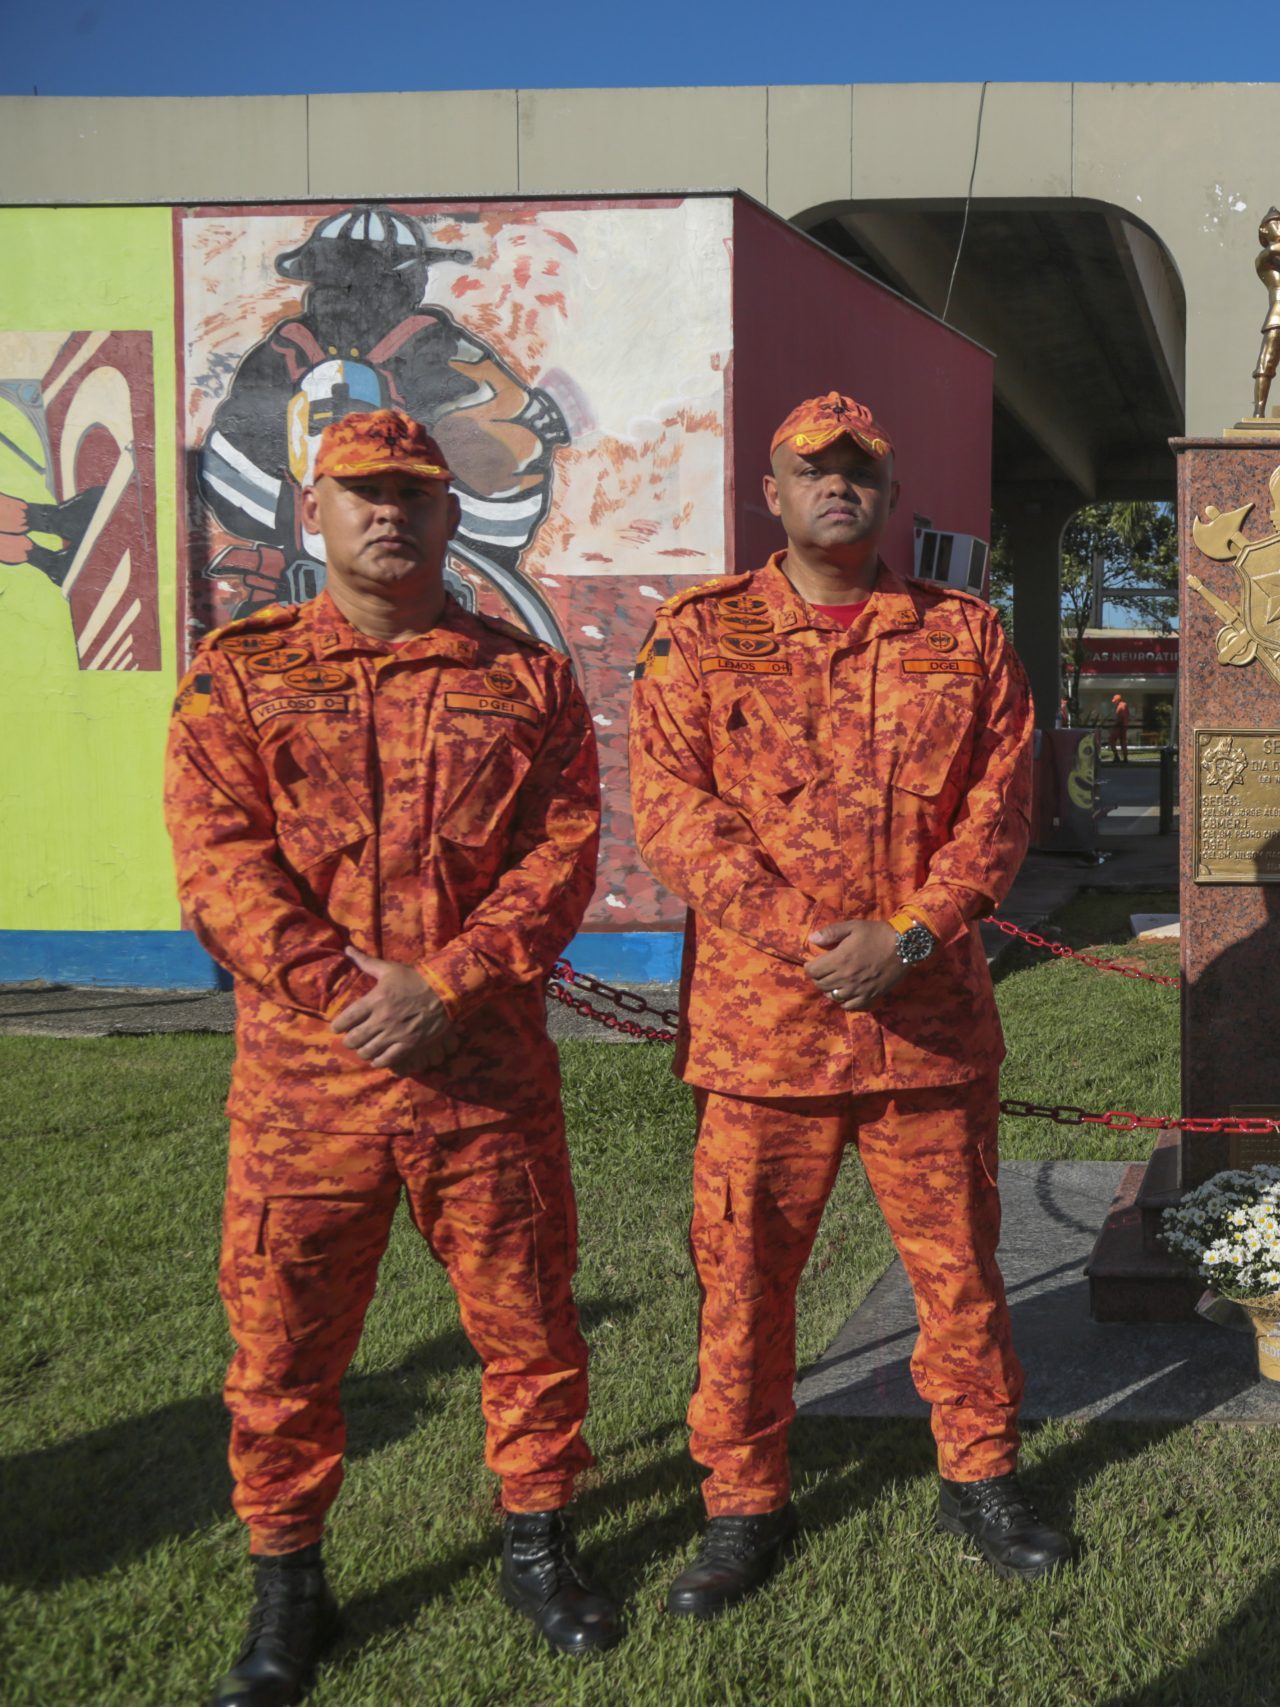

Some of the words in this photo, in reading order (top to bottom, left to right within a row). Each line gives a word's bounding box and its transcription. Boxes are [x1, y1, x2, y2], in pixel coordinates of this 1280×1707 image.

[718, 660, 755, 671] LEMOS
[930, 662, 959, 670] DGEI
[256, 699, 316, 717] VELLOSO
[479, 699, 515, 713] DGEI
[1250, 760, 1269, 772] DIA
[1259, 775, 1272, 784] LEI
[1234, 808, 1261, 816] JORGE
[1235, 830, 1261, 839] PEDRO
